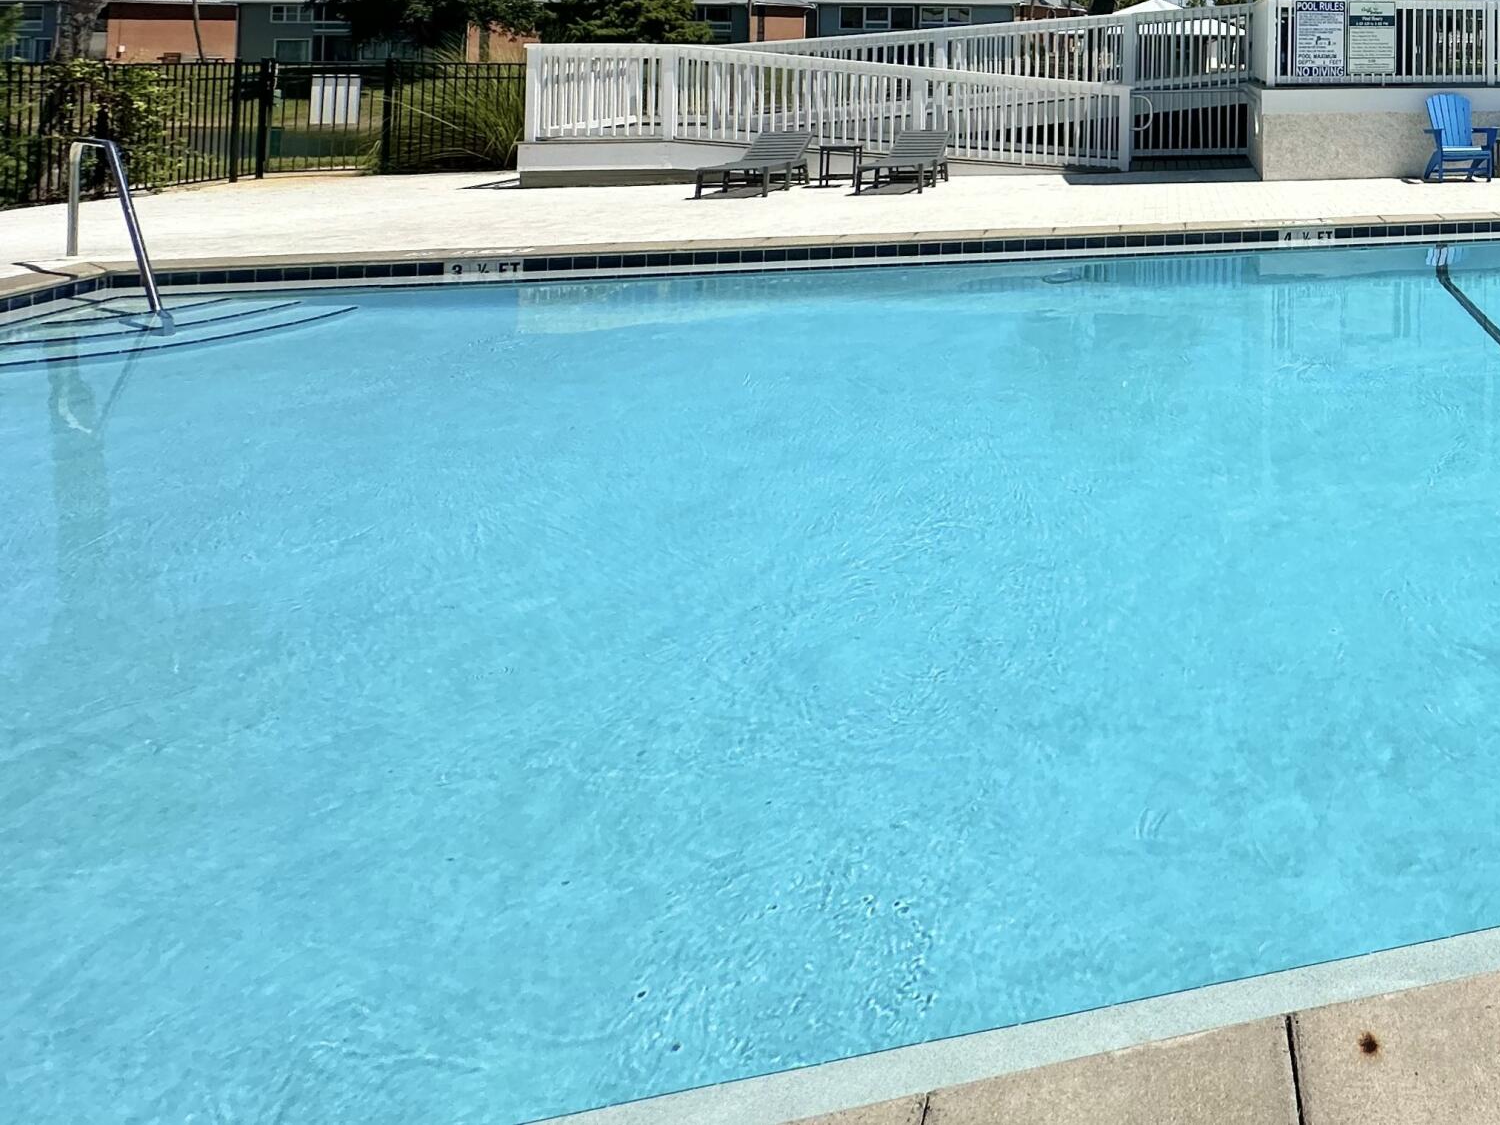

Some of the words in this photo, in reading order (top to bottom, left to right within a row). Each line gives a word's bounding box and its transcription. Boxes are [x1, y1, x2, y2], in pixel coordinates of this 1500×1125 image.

[1297, 2, 1318, 11] POOL
[1320, 2, 1344, 11] RULES
[1297, 66, 1310, 76] NO
[1312, 66, 1344, 76] DIVING
[1317, 231, 1333, 240] FT
[499, 263, 520, 273] FT
